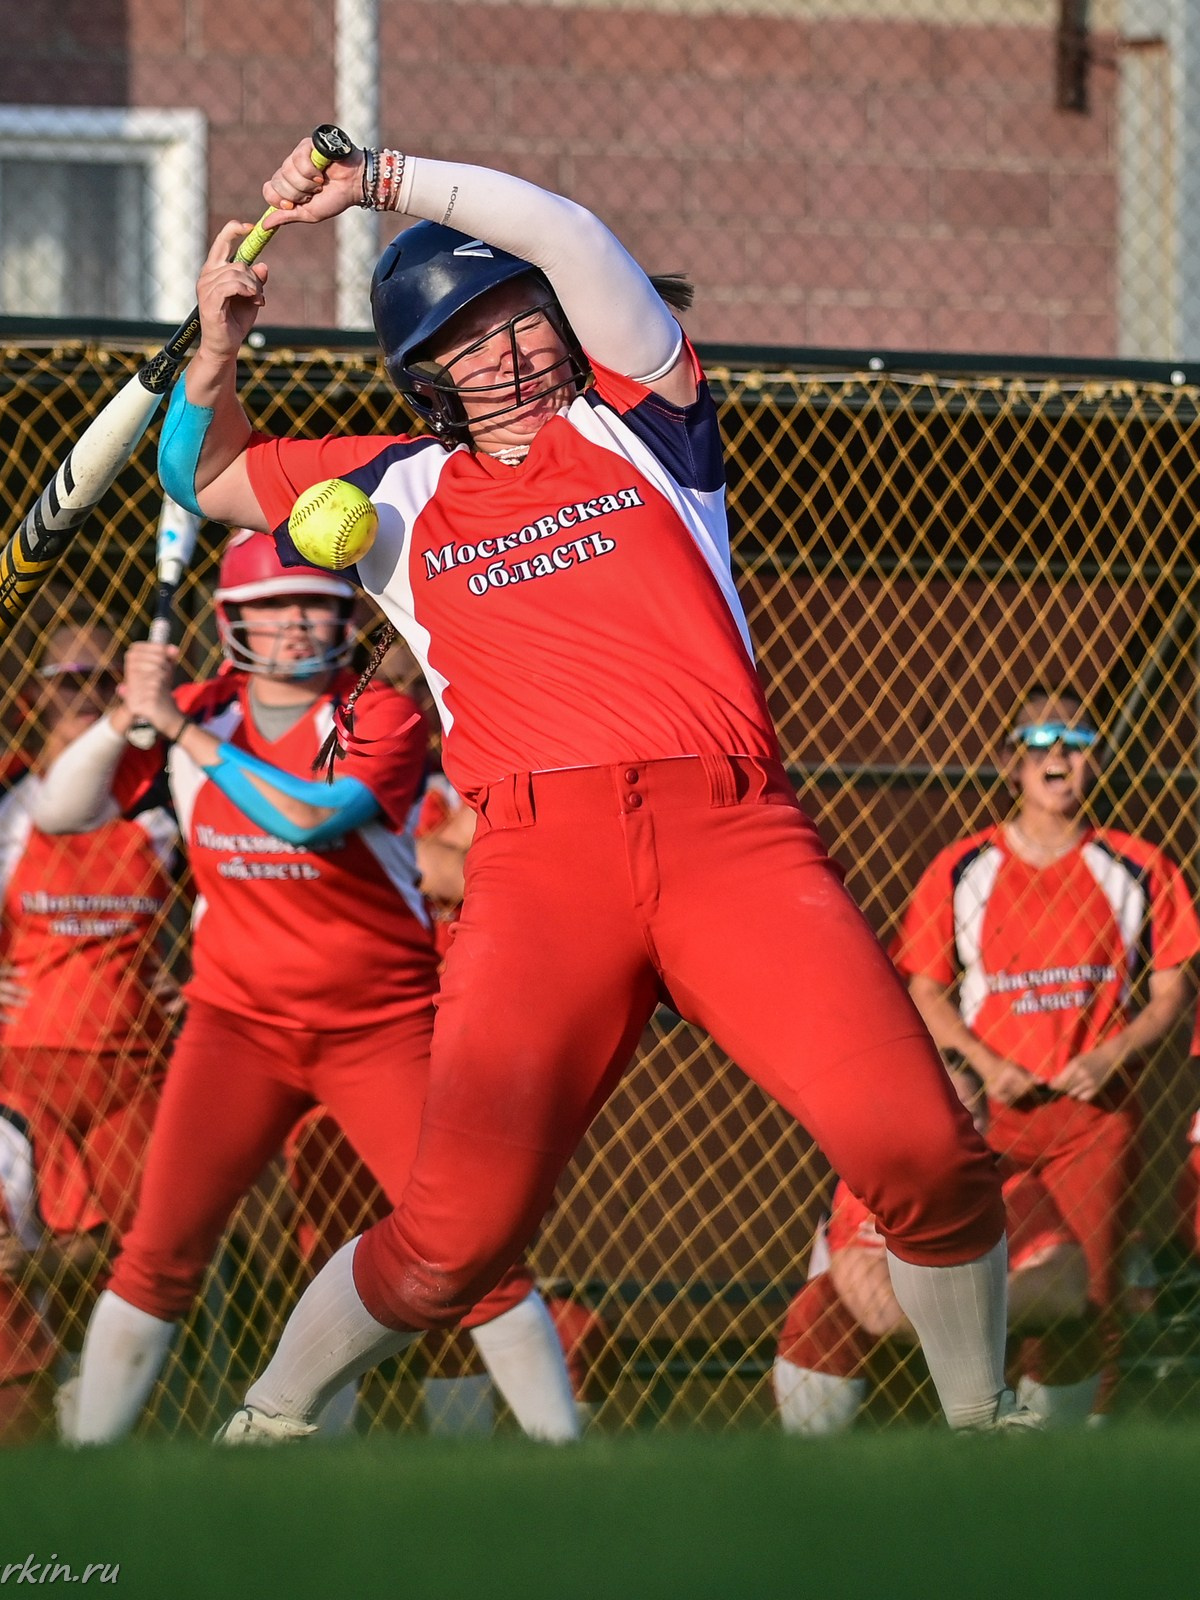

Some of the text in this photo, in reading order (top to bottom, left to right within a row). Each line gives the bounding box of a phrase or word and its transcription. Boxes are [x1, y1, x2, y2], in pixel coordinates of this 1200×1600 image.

[171, 318, 200, 353] LOUISVILLE
[422, 486, 644, 580] Московская
[467, 532, 616, 596] область
